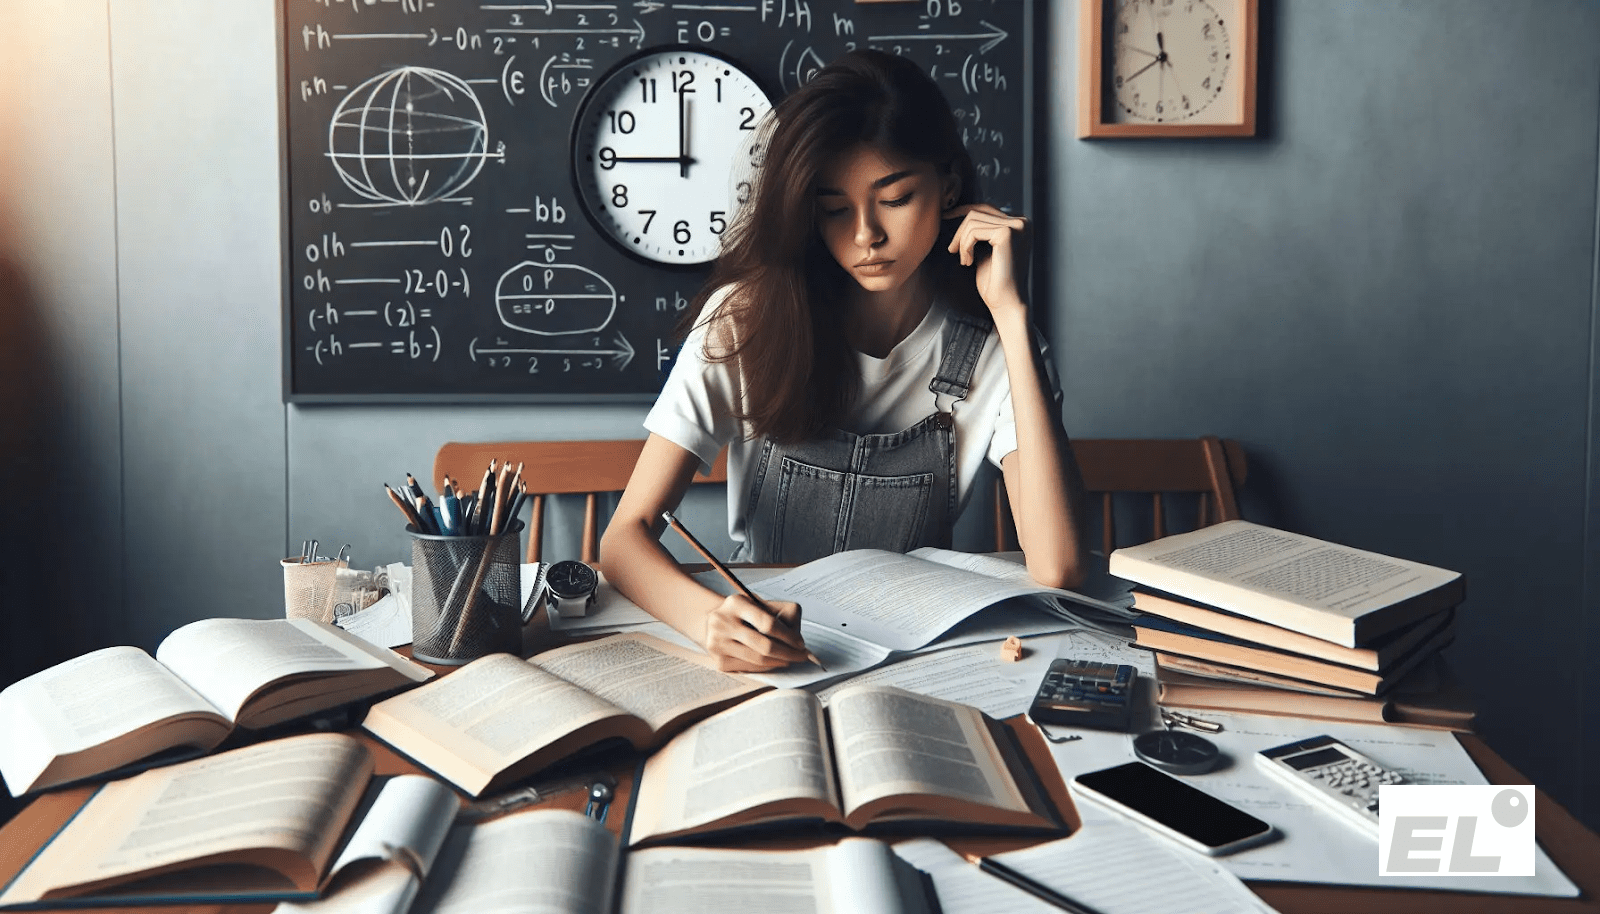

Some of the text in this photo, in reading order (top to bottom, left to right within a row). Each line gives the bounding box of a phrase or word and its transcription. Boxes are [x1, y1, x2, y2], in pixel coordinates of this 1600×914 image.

[639, 77, 656, 103] 11
[671, 70, 696, 93] 12
[714, 77, 722, 103] 1
[607, 110, 636, 134] 10
[739, 107, 756, 130] 2
[599, 146, 617, 170] 9
[612, 184, 628, 208] 8
[637, 210, 657, 234] 7
[673, 220, 691, 244] 6
[709, 211, 727, 235] 5
